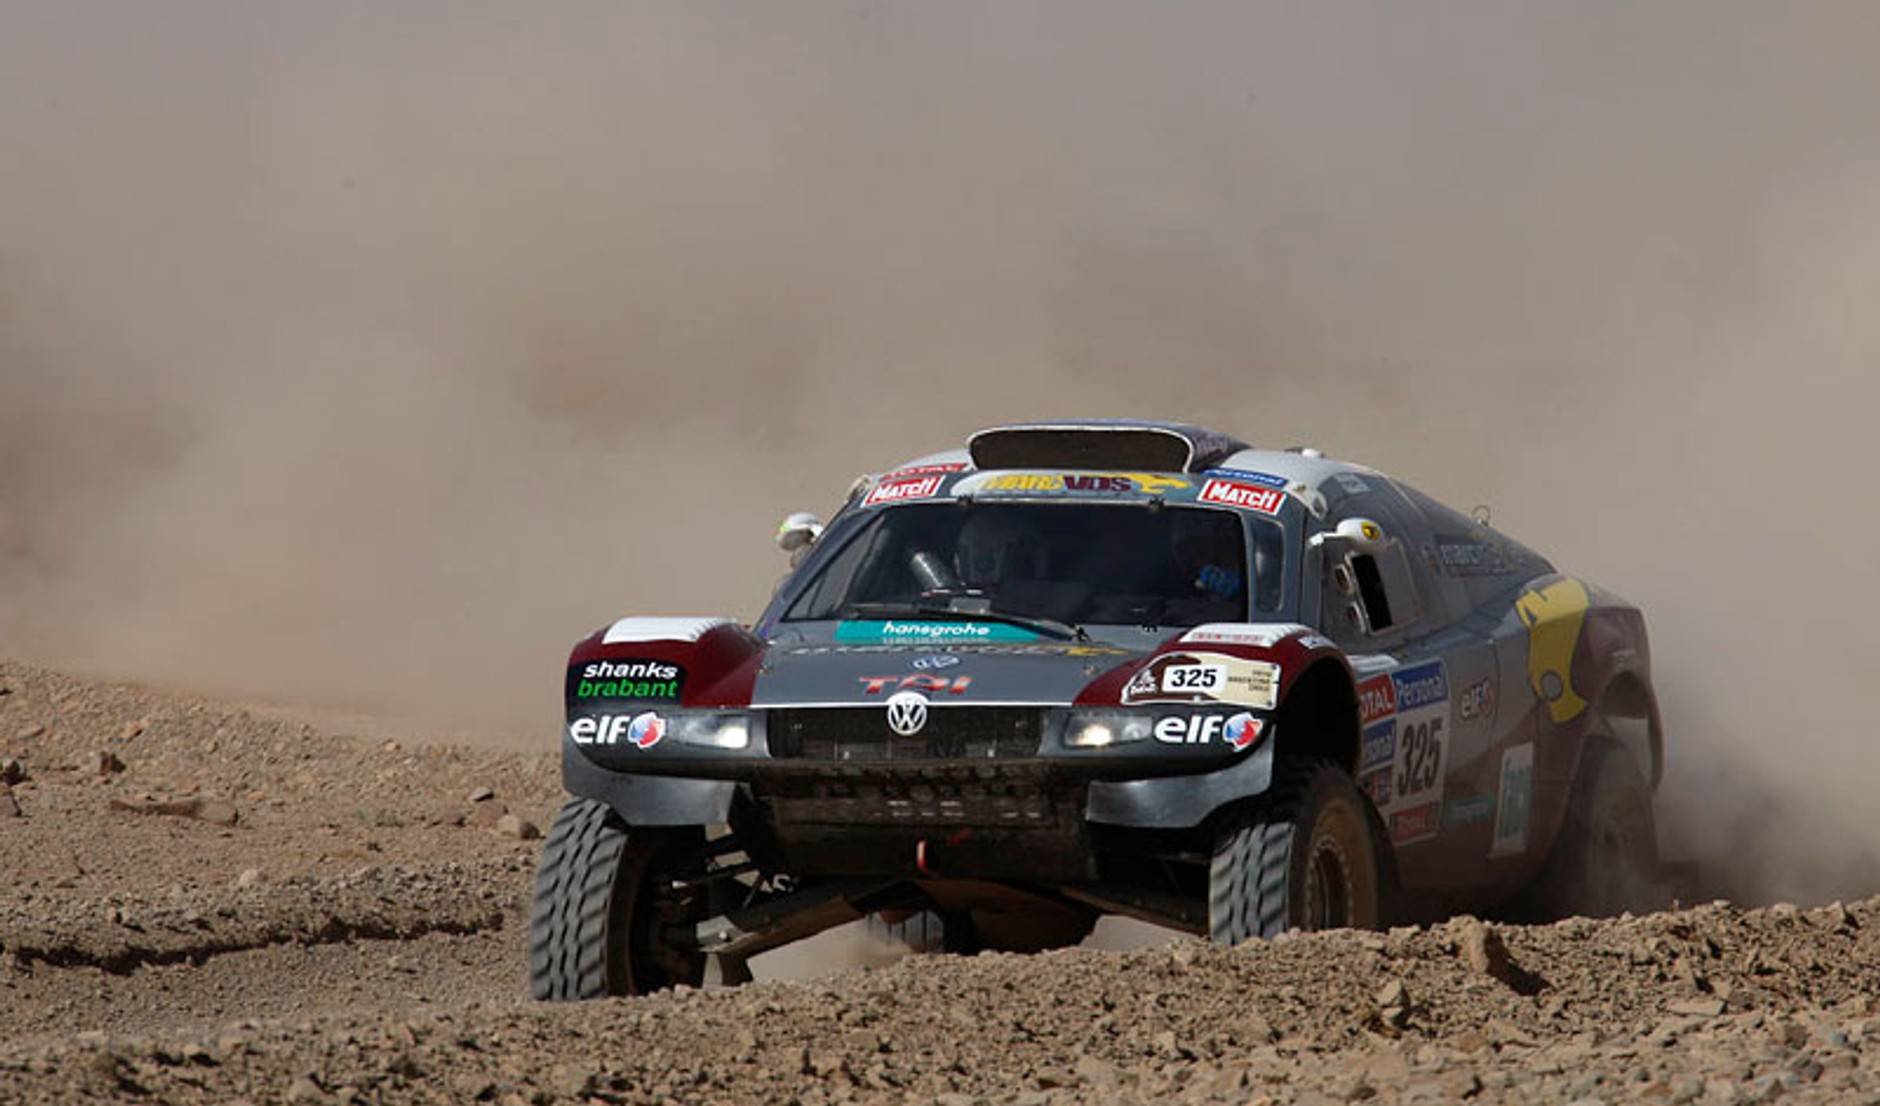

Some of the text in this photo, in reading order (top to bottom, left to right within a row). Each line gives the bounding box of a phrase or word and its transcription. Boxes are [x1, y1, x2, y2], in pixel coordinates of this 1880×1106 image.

[872, 477, 937, 500] MATCH
[1208, 483, 1278, 509] MATCH
[882, 621, 991, 638] hansgrohe
[583, 661, 679, 680] shanks
[1170, 668, 1217, 688] 325
[577, 679, 679, 698] brabant
[1397, 717, 1444, 796] 325
